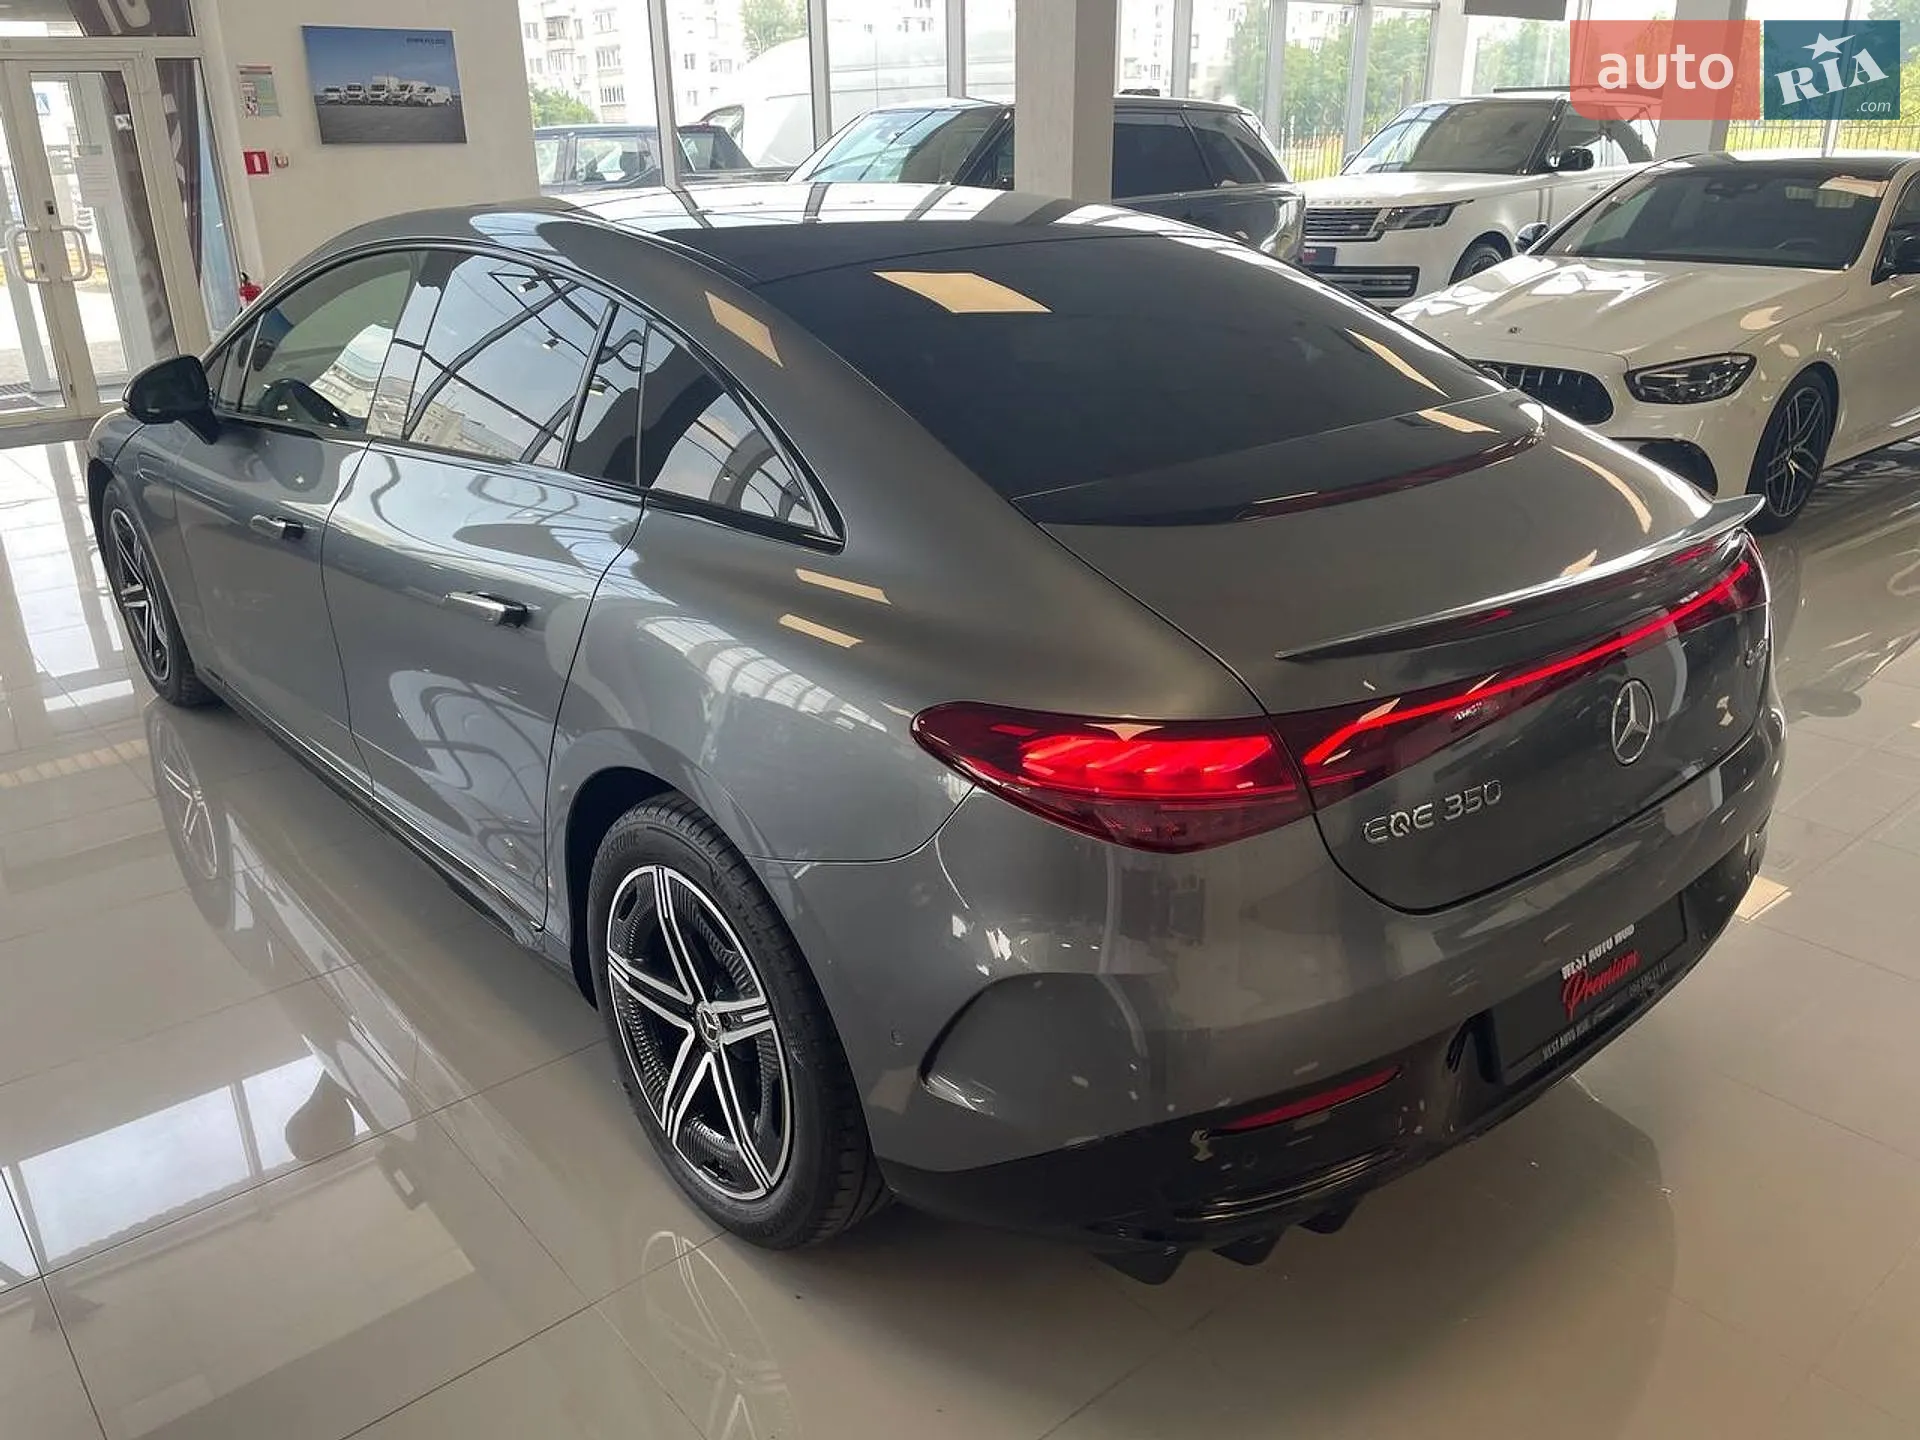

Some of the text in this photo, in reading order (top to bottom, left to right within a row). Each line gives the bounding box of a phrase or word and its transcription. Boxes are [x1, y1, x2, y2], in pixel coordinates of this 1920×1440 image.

[1364, 780, 1502, 843] EQE 350
[1561, 955, 1587, 980] WEST
[1588, 937, 1614, 963] AUTO
[1561, 949, 1641, 1022] Premium
